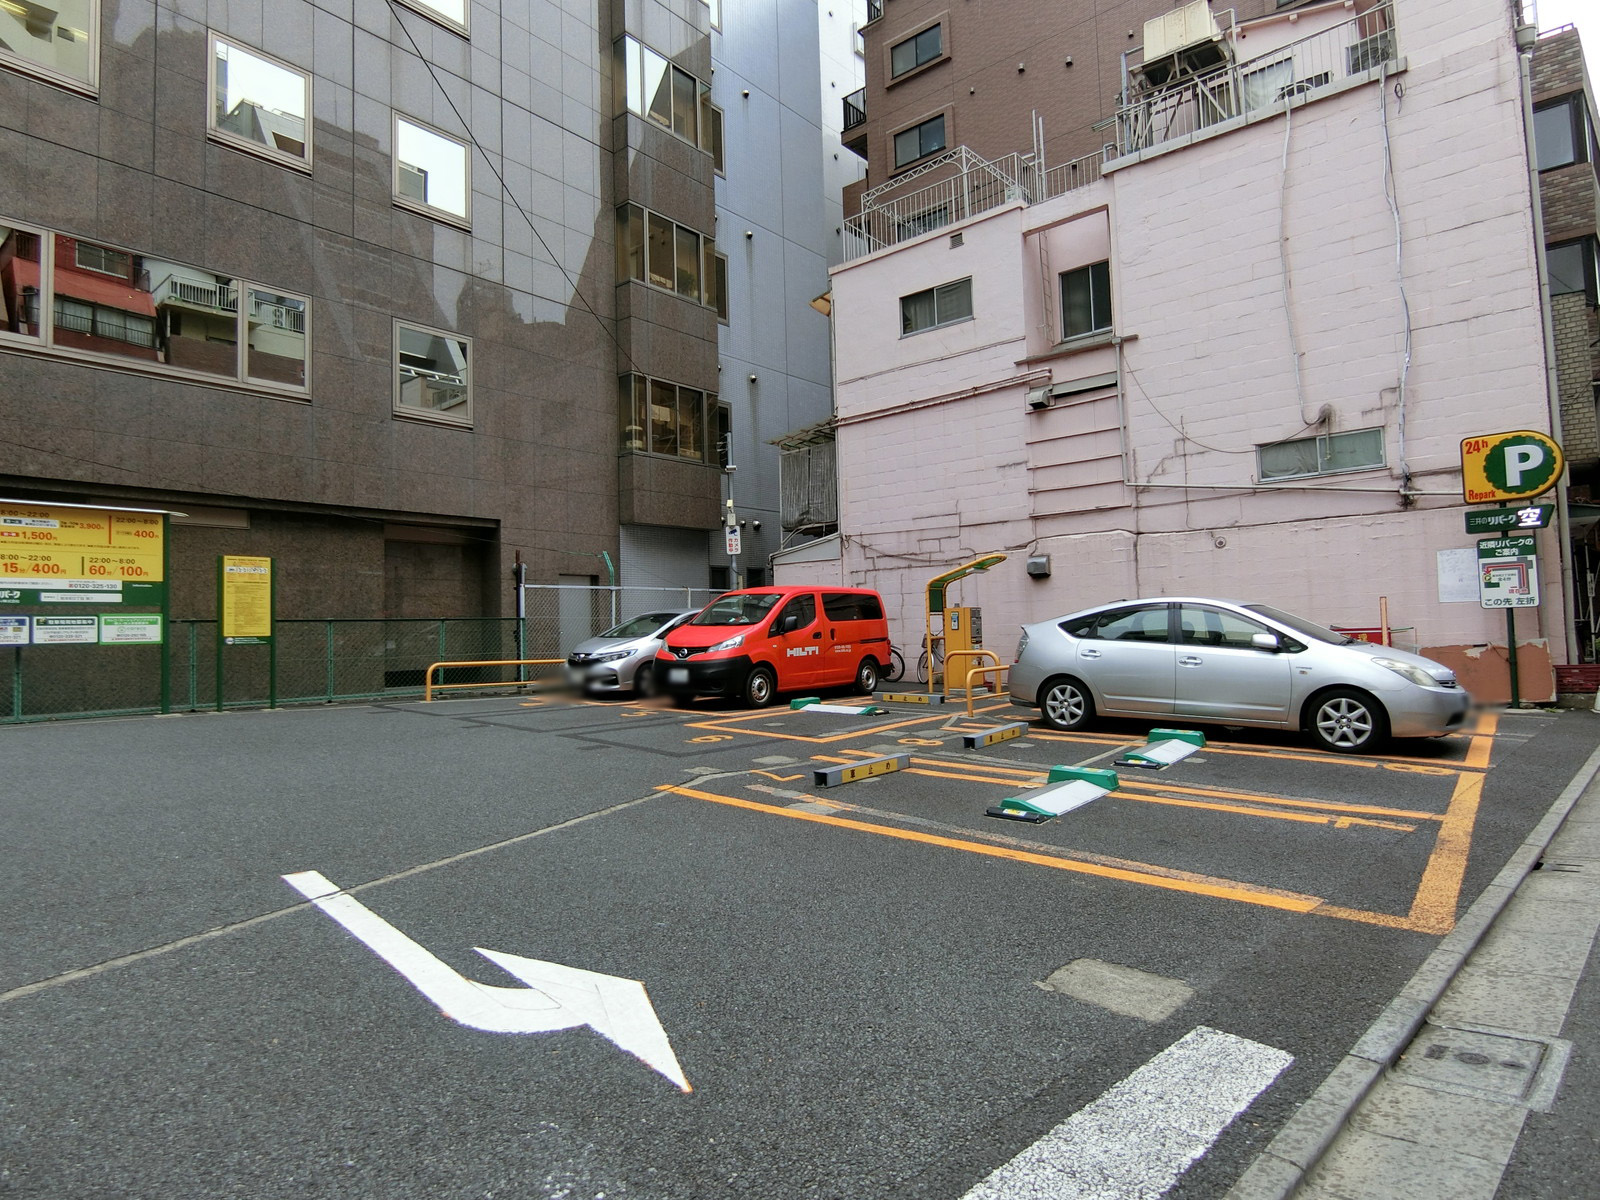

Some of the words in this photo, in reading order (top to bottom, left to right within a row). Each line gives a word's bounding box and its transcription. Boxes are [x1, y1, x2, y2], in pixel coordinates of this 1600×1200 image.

[1465, 439, 1489, 455] 24h
[1504, 444, 1544, 487] P
[1468, 489, 1497, 501] Repark
[1469, 515, 1517, 526] 三井のリパーク
[1517, 507, 1542, 527] 空
[1479, 538, 1534, 549] 近隣リパークの
[1495, 547, 1519, 556] ご案内
[1484, 598, 1513, 606] この先
[1515, 596, 1536, 605] 左折
[786, 646, 820, 657] HILTI
[850, 762, 891, 779] 車止め
